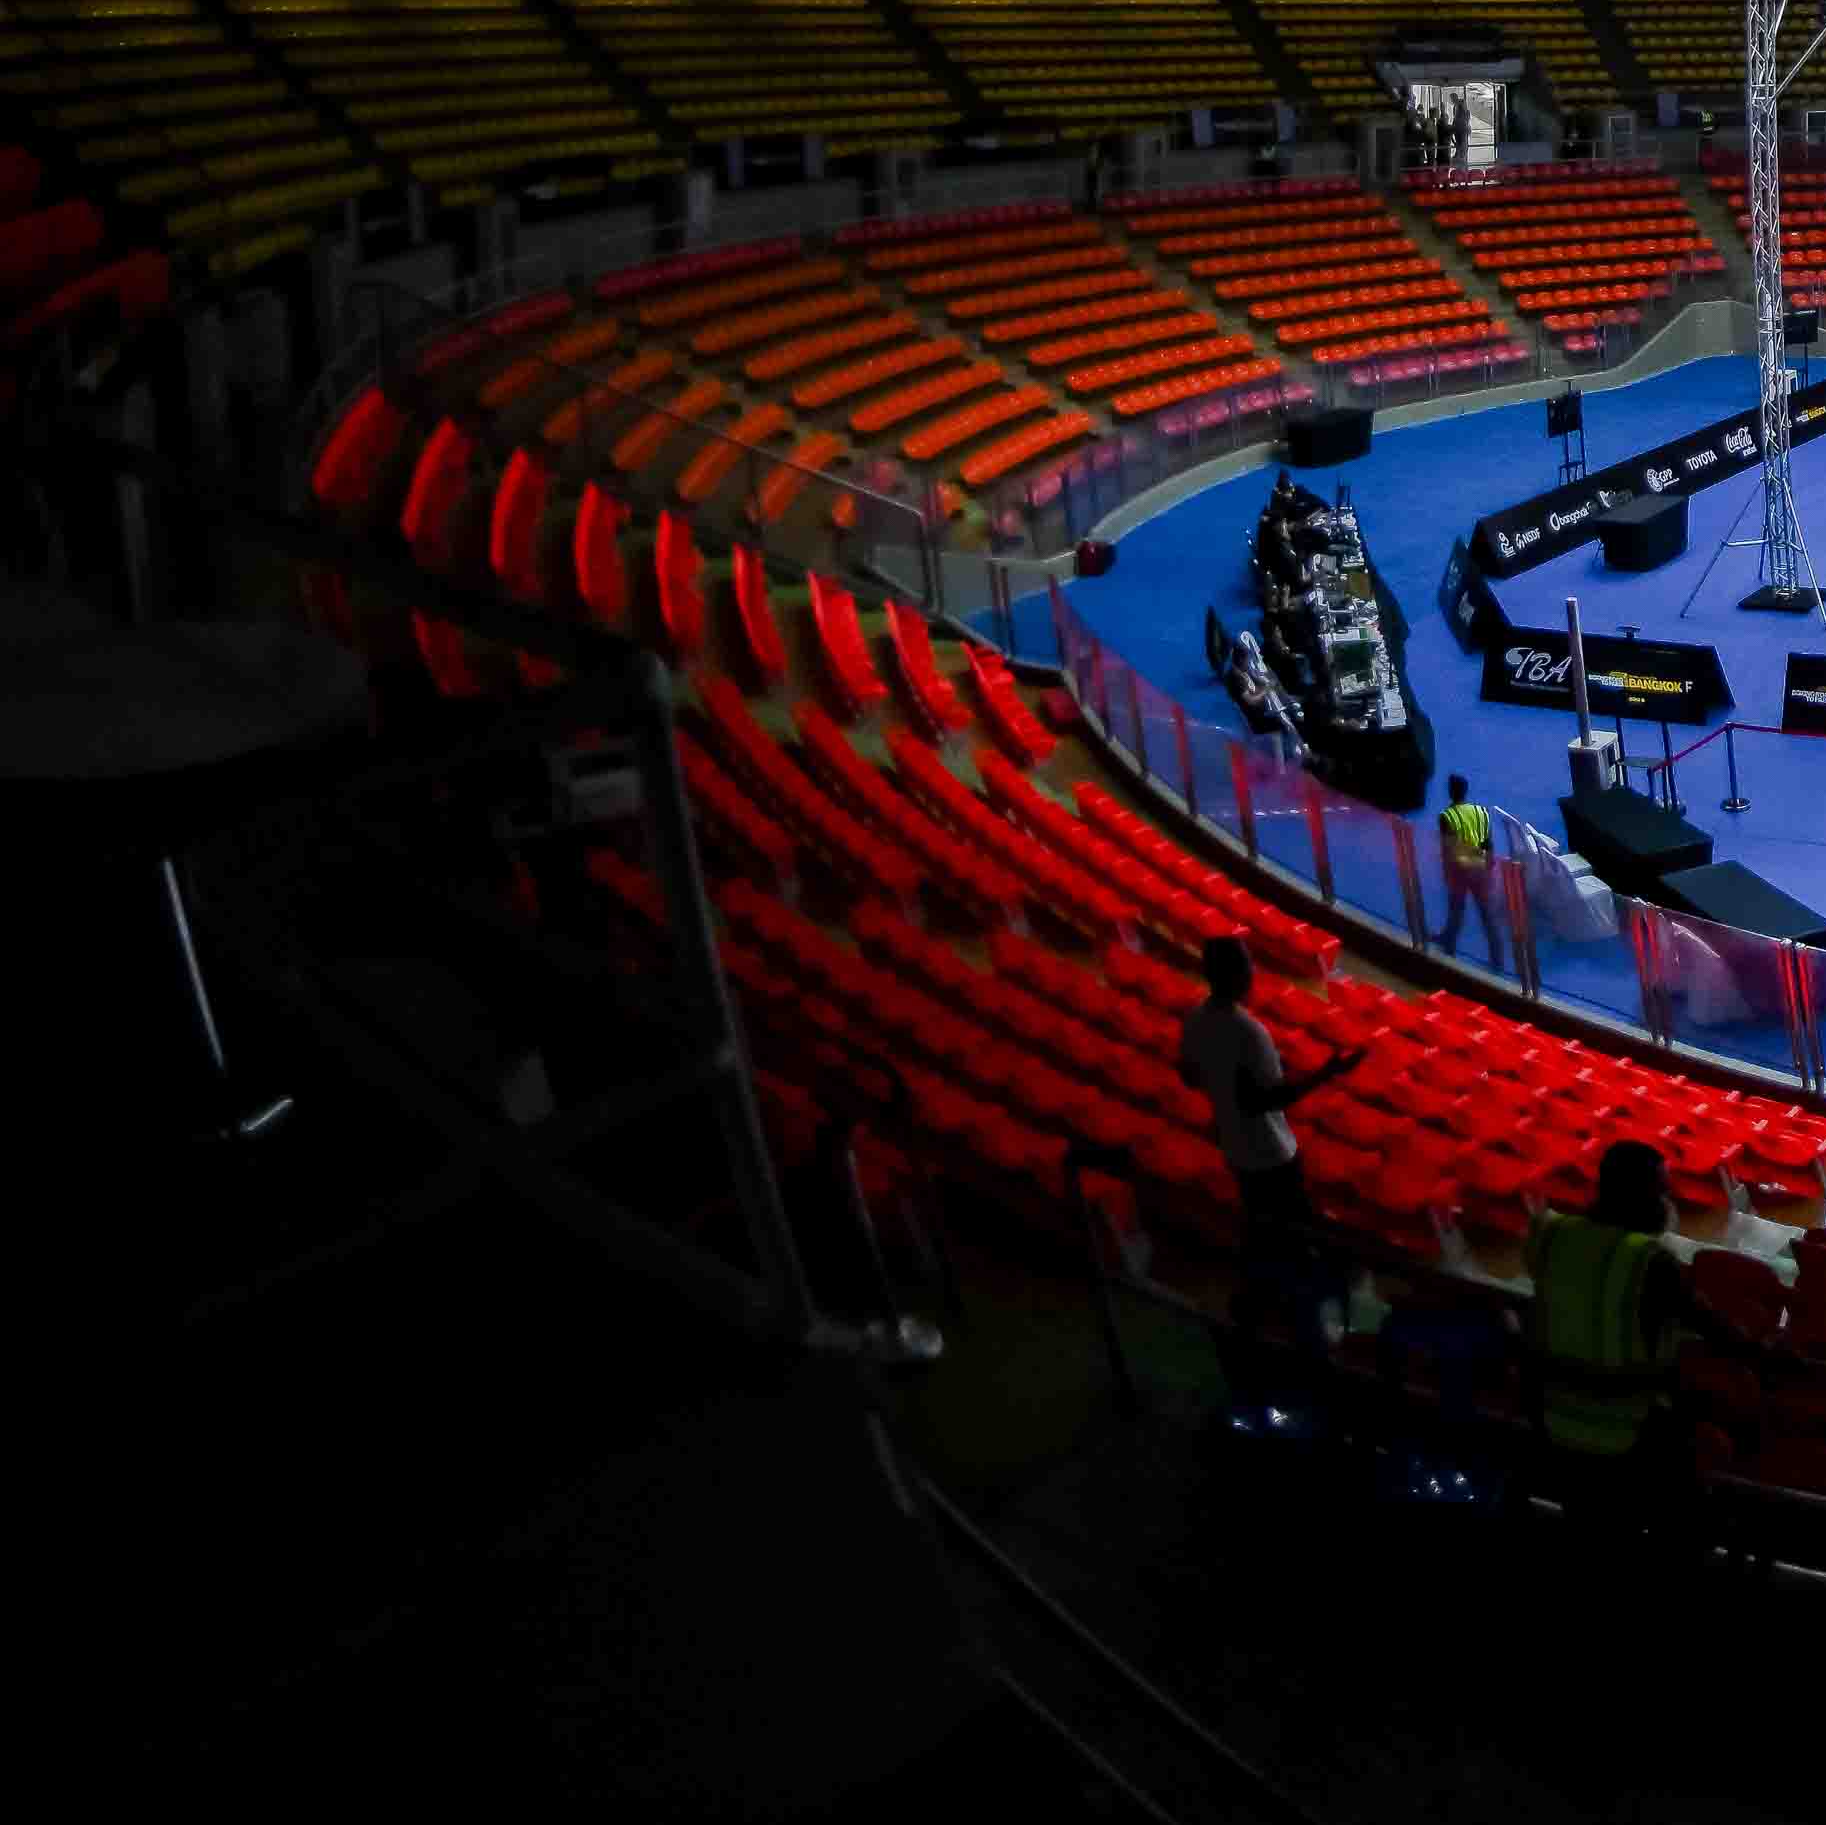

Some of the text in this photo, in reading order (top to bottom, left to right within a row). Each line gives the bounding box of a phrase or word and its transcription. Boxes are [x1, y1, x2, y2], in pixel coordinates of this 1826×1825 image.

[1687, 450, 1718, 471] TOYOTA
[1523, 528, 1541, 545] NSDF
[1629, 677, 1682, 694] BANGKOK
